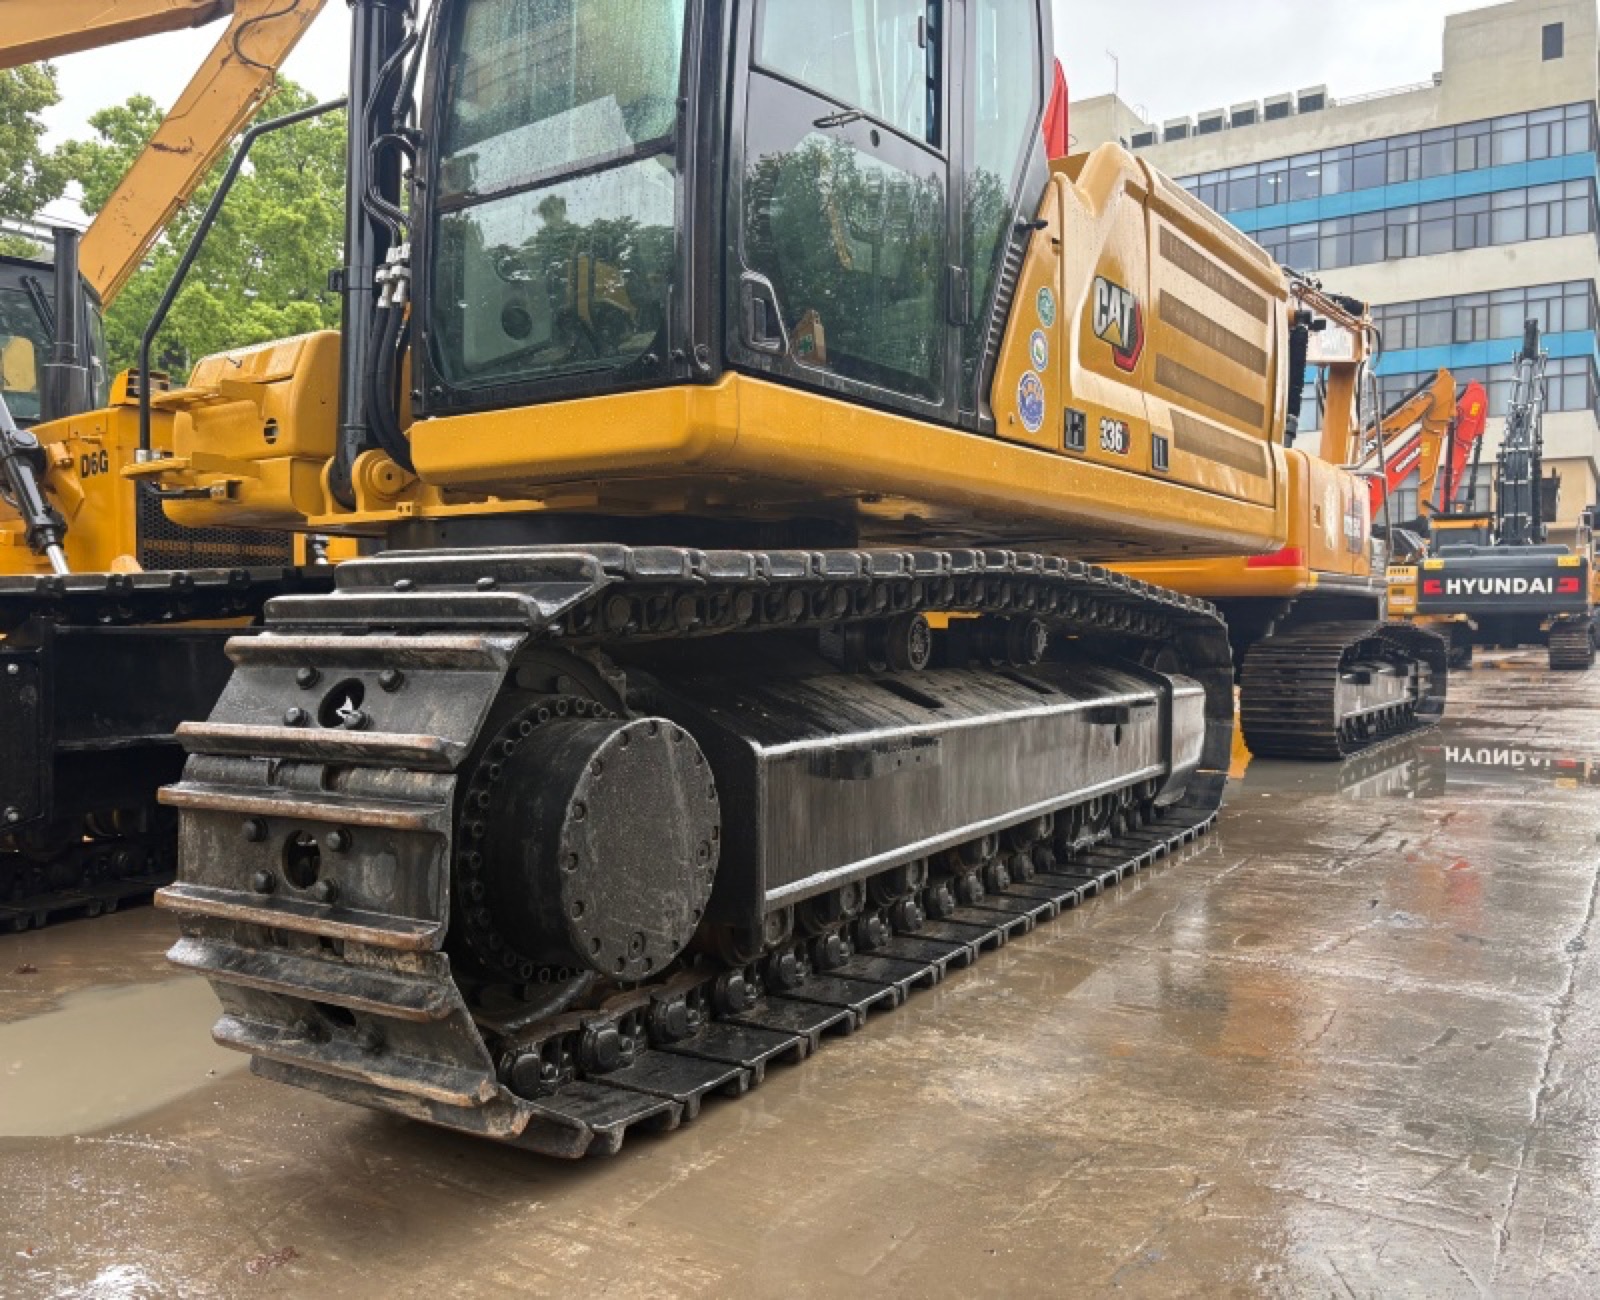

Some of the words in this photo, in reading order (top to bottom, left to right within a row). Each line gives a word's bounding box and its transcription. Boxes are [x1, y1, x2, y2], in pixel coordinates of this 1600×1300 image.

[1094, 276, 1135, 348] CAT
[1100, 416, 1123, 453] 336
[81, 449, 109, 478] D6G
[1446, 577, 1553, 595] HYUNDAI
